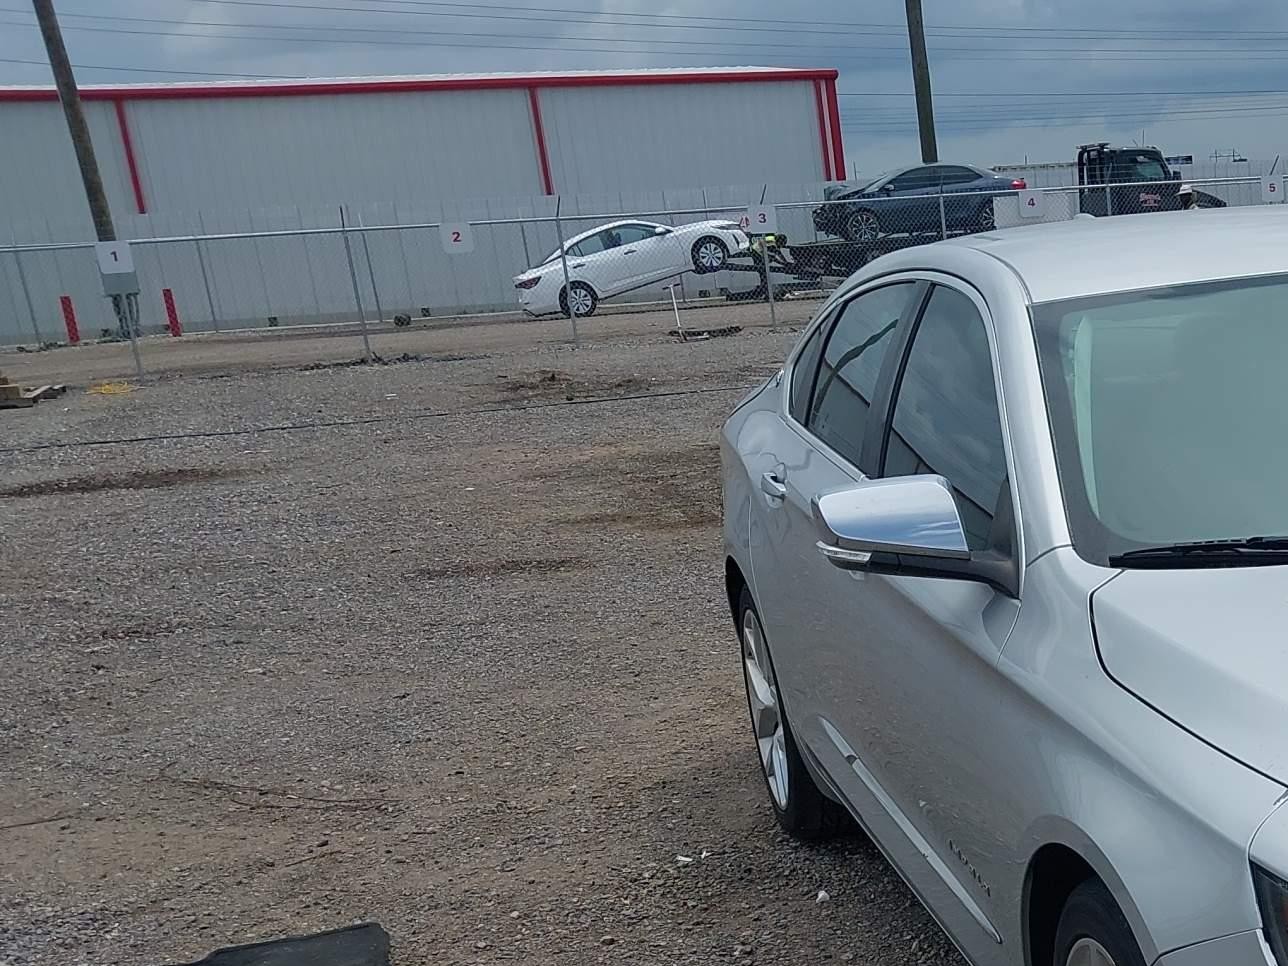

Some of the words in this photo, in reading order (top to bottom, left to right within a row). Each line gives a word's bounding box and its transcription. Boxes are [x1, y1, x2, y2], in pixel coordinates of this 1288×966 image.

[1269, 183, 1276, 192] 5
[1028, 197, 1036, 207] 4
[758, 213, 767, 223] 3
[451, 231, 462, 242] 2
[110, 251, 118, 262] 1
